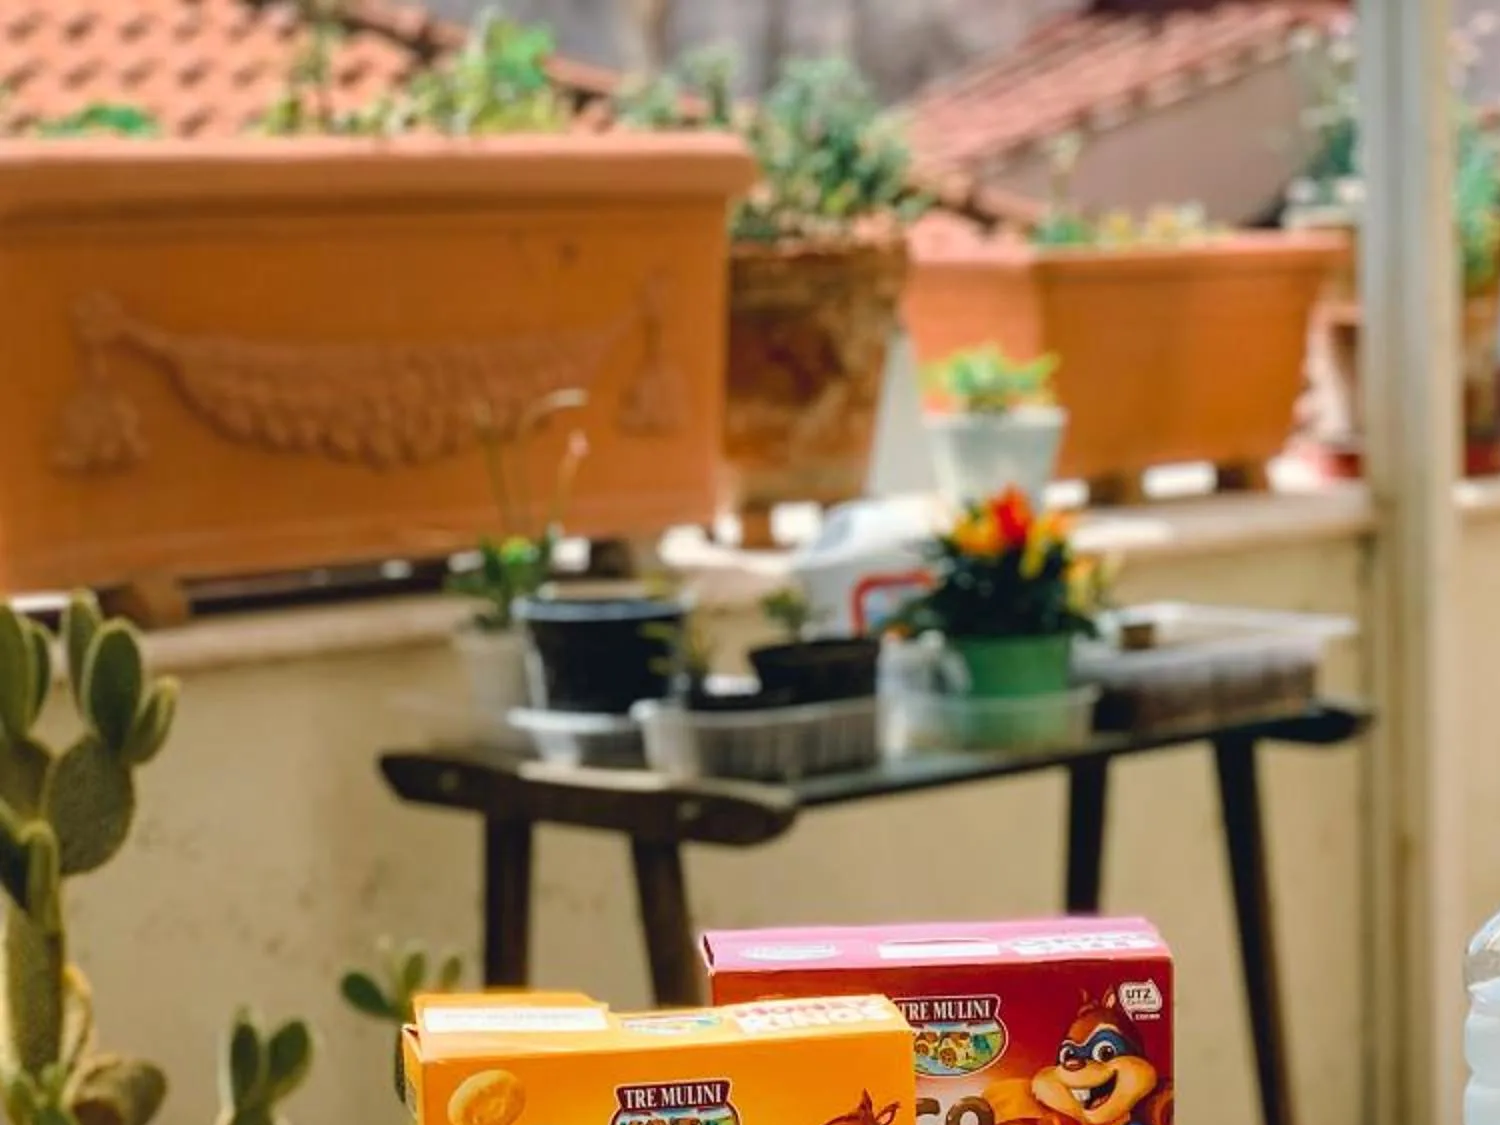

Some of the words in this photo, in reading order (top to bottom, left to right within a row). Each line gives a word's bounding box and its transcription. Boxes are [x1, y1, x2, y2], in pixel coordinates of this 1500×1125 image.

[1126, 988, 1153, 999] UTZ
[902, 1002, 930, 1020] TRE
[933, 1000, 991, 1019] MULINI
[624, 1087, 658, 1109] TRE
[661, 1083, 722, 1106] MULINI
